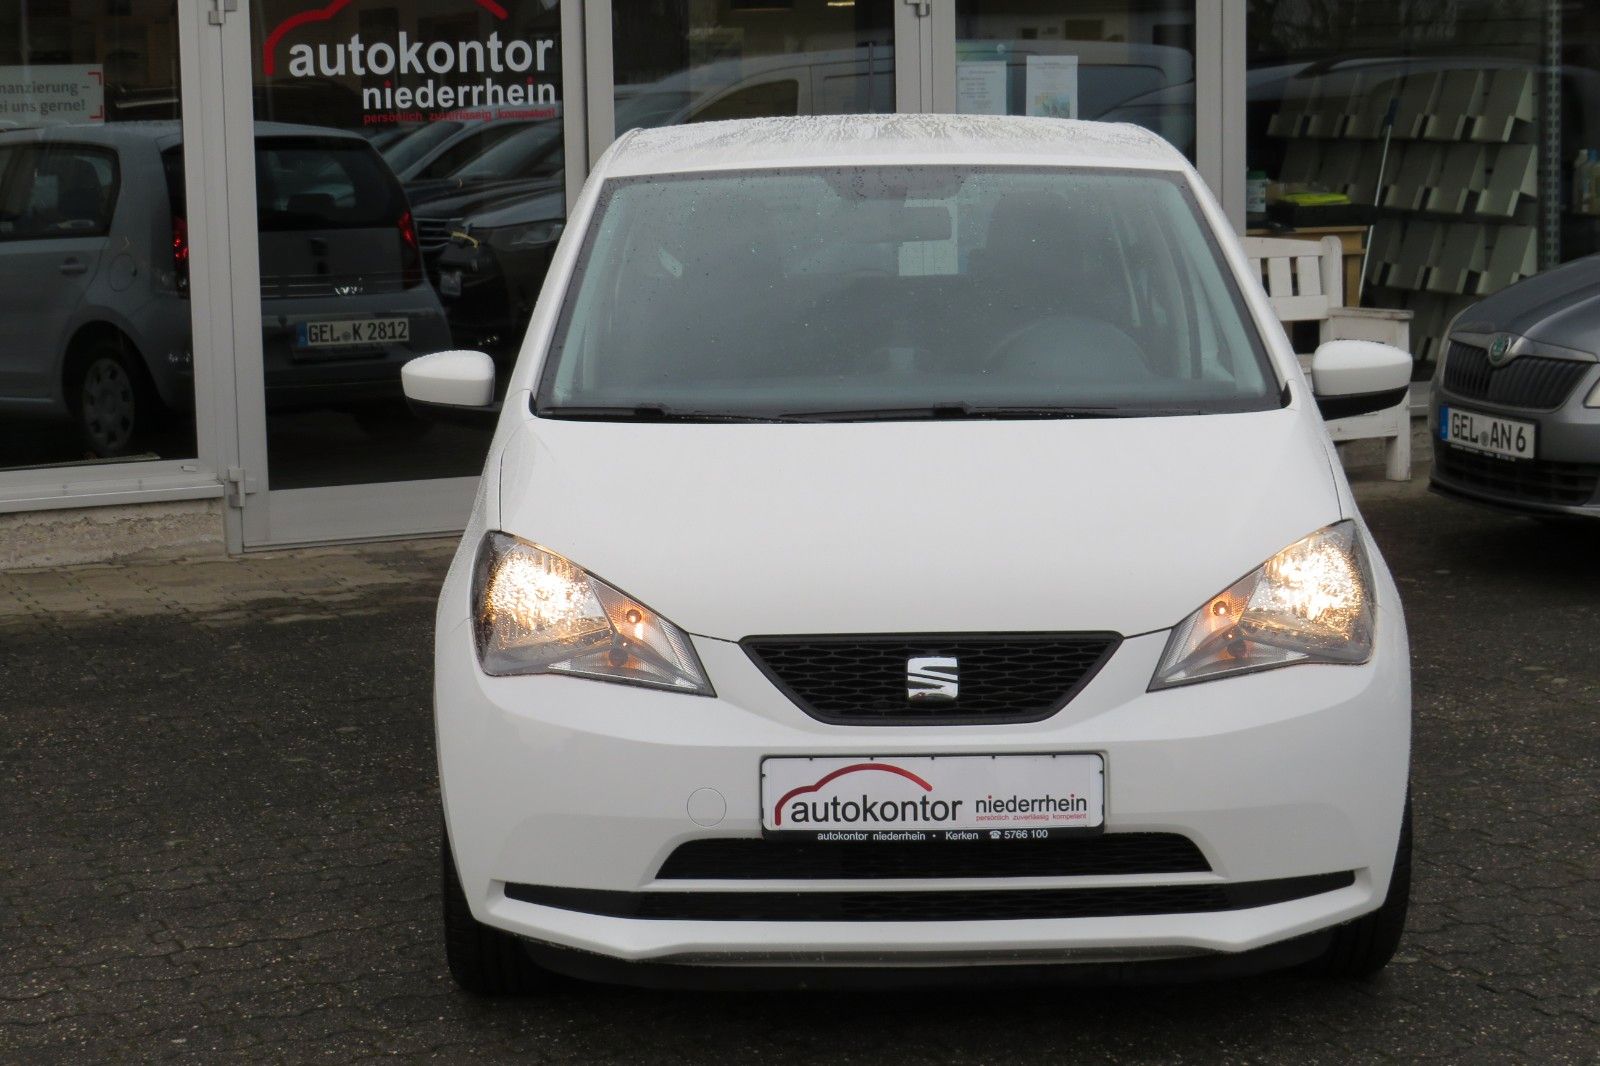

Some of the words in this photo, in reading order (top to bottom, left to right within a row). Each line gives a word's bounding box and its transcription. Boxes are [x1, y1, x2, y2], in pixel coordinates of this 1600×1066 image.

[288, 31, 553, 78] autokontor
[12, 102, 37, 113] uns
[40, 99, 86, 115] gerne!
[363, 76, 557, 110] niederrhein
[308, 323, 341, 344] GEL
[353, 323, 363, 341] K
[368, 320, 408, 341] 2812
[1452, 413, 1479, 444] GEL
[1490, 421, 1512, 451] AN
[1515, 426, 1526, 453] 6
[790, 794, 963, 823] autokontor
[976, 793, 1087, 813] niederrhein
[817, 832, 868, 841] autokontor
[873, 831, 926, 841] niederrhein
[945, 831, 979, 840] Kerken
[1004, 830, 1028, 839] 5766
[1031, 829, 1049, 838] 100
